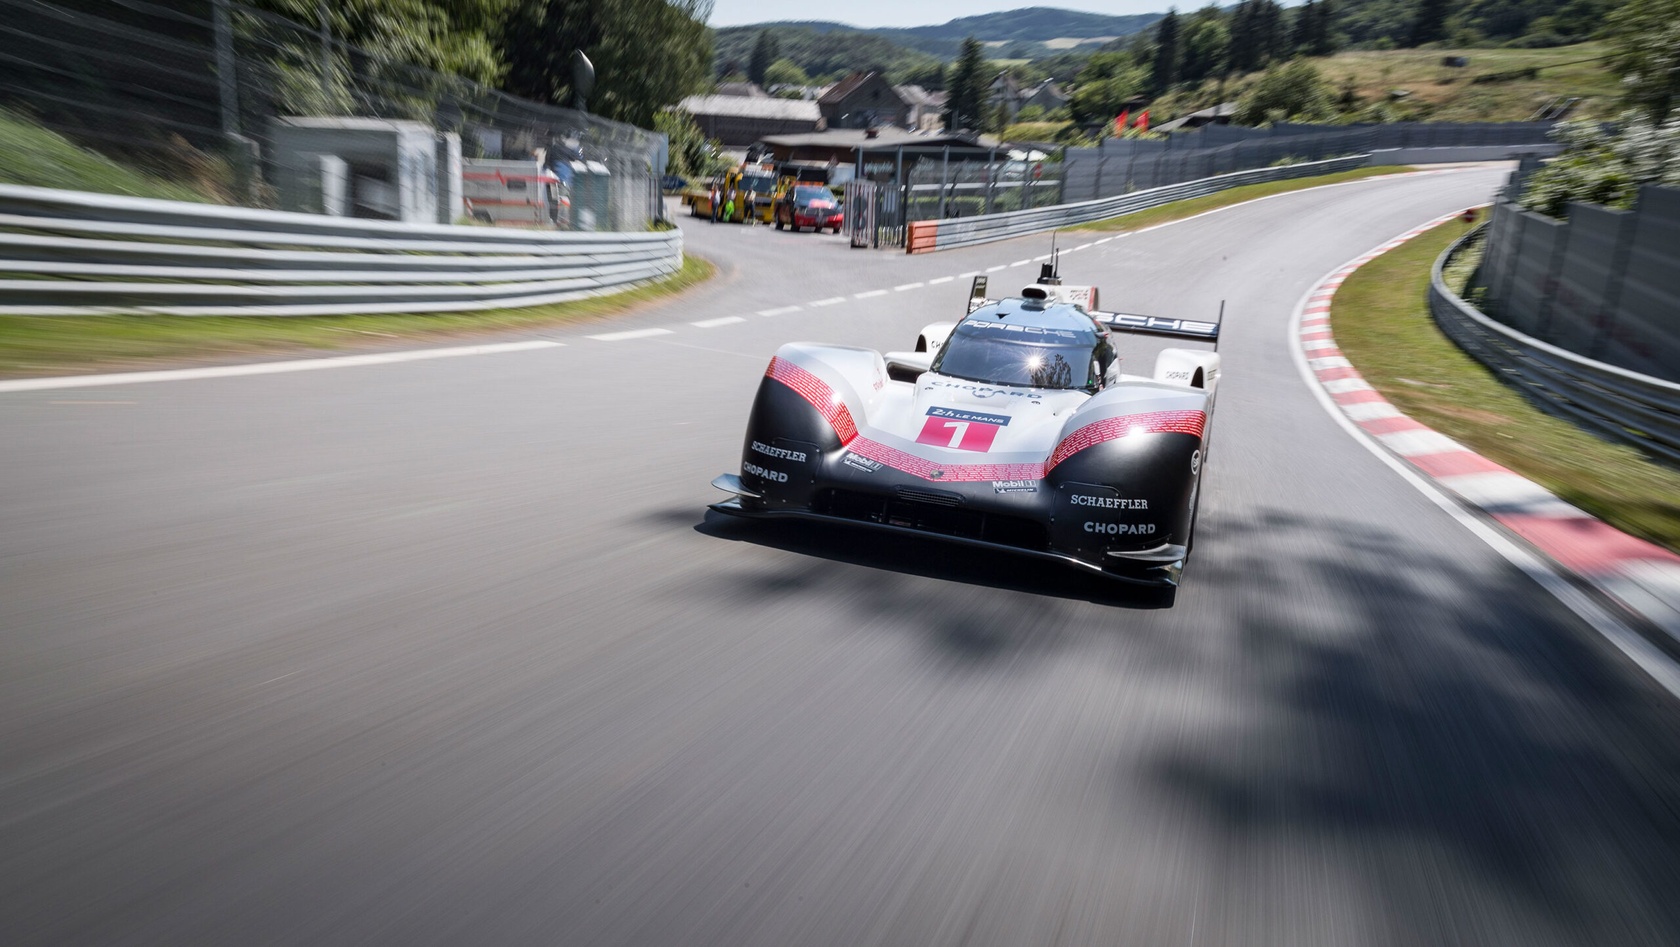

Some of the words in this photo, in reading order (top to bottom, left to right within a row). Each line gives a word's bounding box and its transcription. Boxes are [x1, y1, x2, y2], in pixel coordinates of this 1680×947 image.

[963, 319, 1077, 338] PORSCHE
[931, 381, 1043, 399] CHOPARD
[971, 416, 1005, 424] MANS
[943, 421, 970, 449] 1
[751, 440, 807, 463] SCHAEFFLER
[743, 461, 789, 483] CHOPARD
[992, 480, 1024, 488] Mobil
[1070, 494, 1149, 510] SCHAEFFLER
[1083, 521, 1156, 535] CHOPARD
